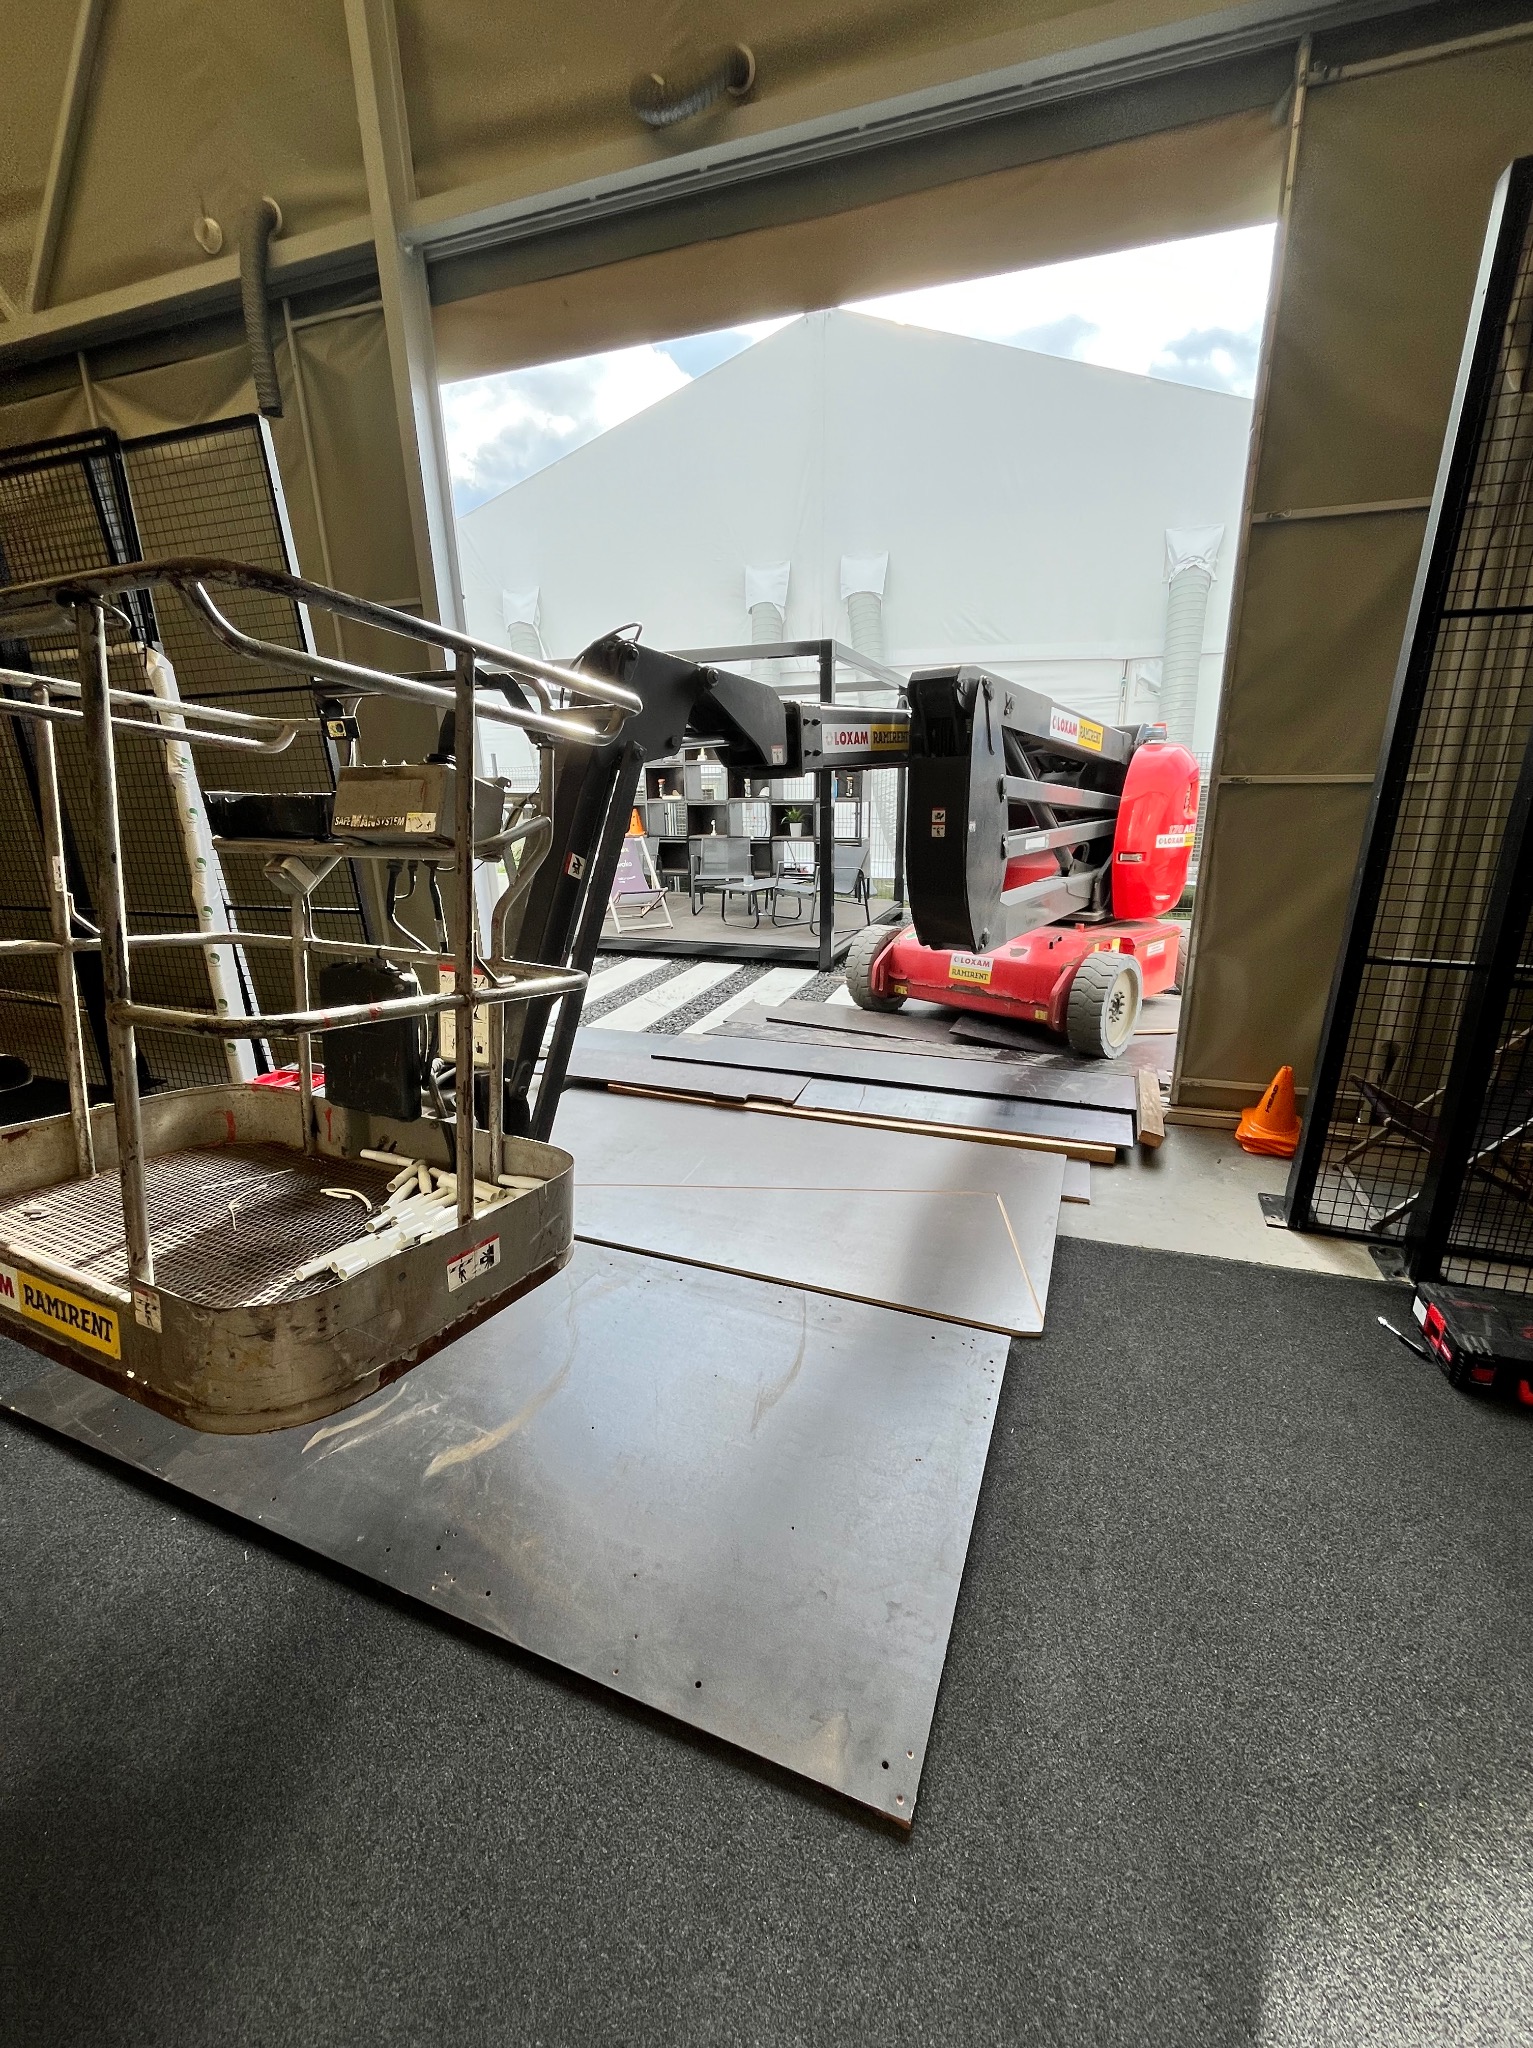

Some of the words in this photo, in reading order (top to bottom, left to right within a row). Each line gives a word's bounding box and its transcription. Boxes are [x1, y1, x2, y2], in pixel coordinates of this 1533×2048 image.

[1057, 716, 1077, 736] LOXAM
[834, 731, 869, 746] LOXAM
[960, 957, 990, 967] LOXAM
[951, 968, 988, 980] RAMIRENT
[23, 1283, 114, 1343] RAMIRENT
